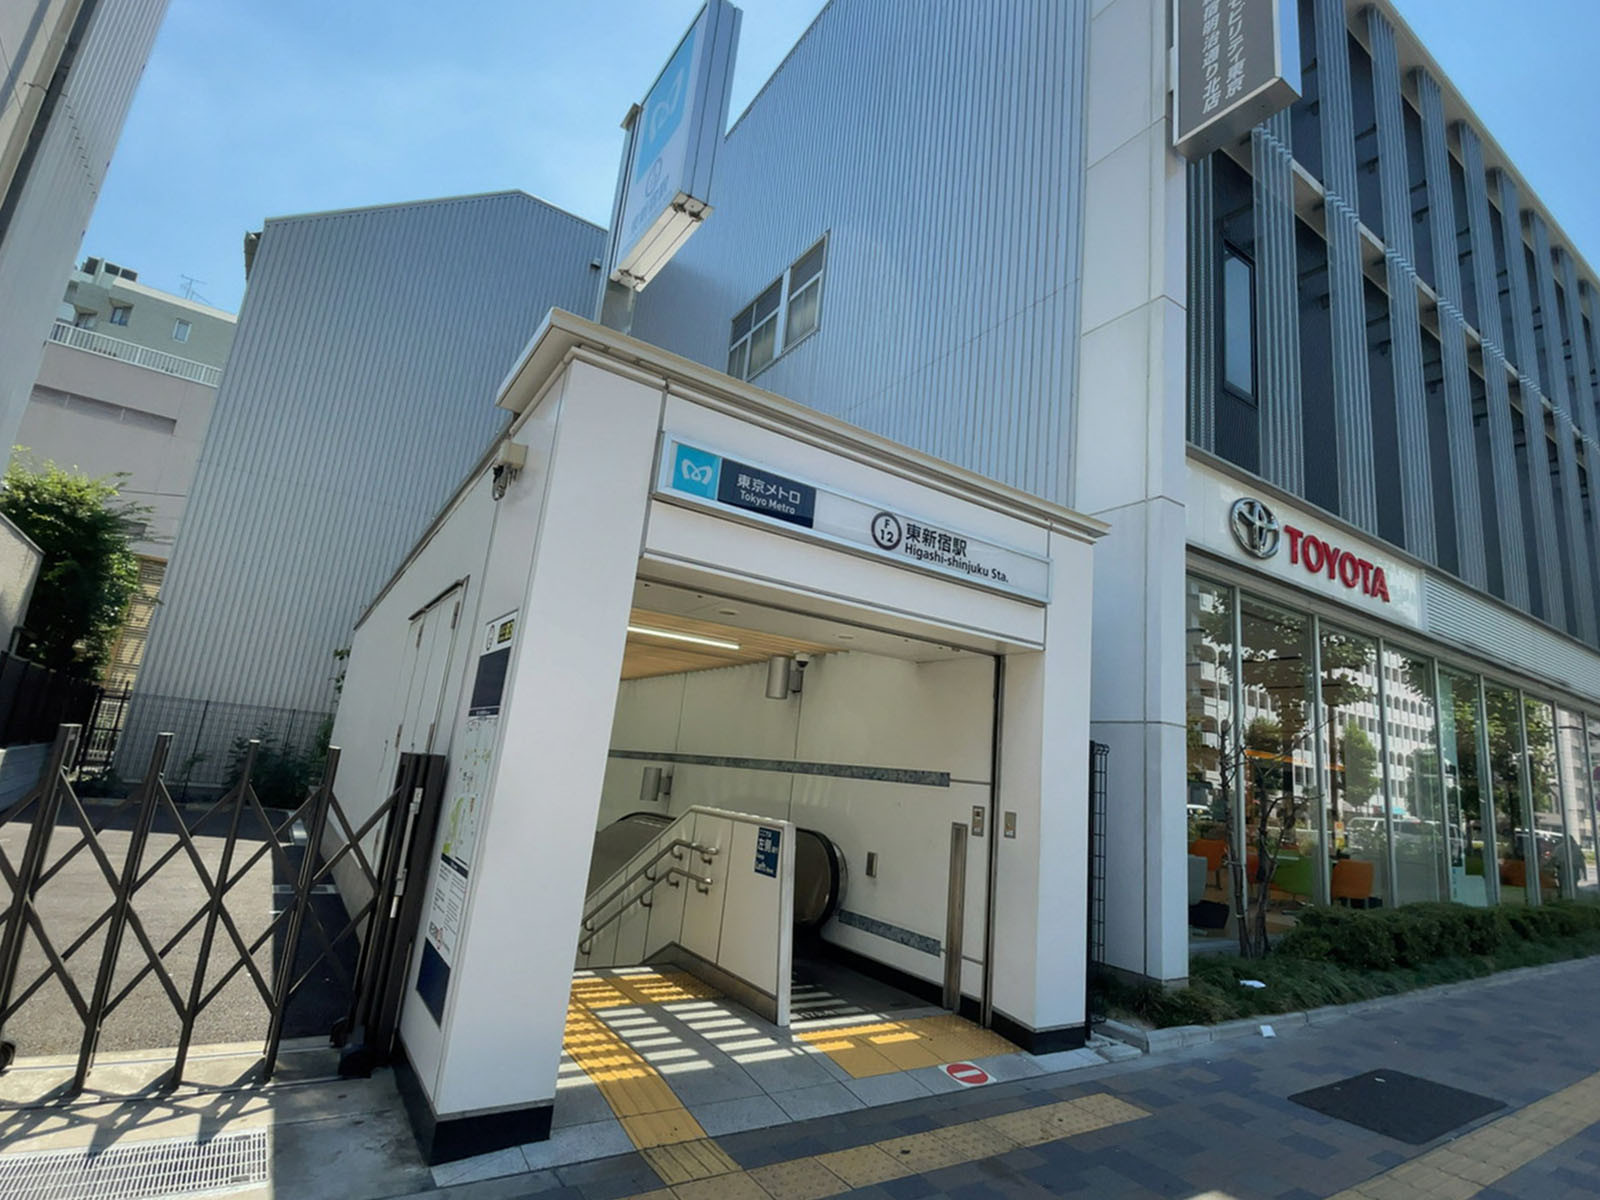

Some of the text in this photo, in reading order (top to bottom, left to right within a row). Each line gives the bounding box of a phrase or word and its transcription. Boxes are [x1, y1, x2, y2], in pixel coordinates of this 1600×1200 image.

[736, 473, 801, 505] 東京メトロ
[740, 490, 796, 515] Tokyo Metro
[879, 529, 894, 544] 12
[883, 518, 891, 530] F
[906, 522, 967, 557] 東新宿駅
[904, 543, 1009, 583] Higashi-shinjuku Sta.
[1283, 524, 1391, 603] TOYOTA
